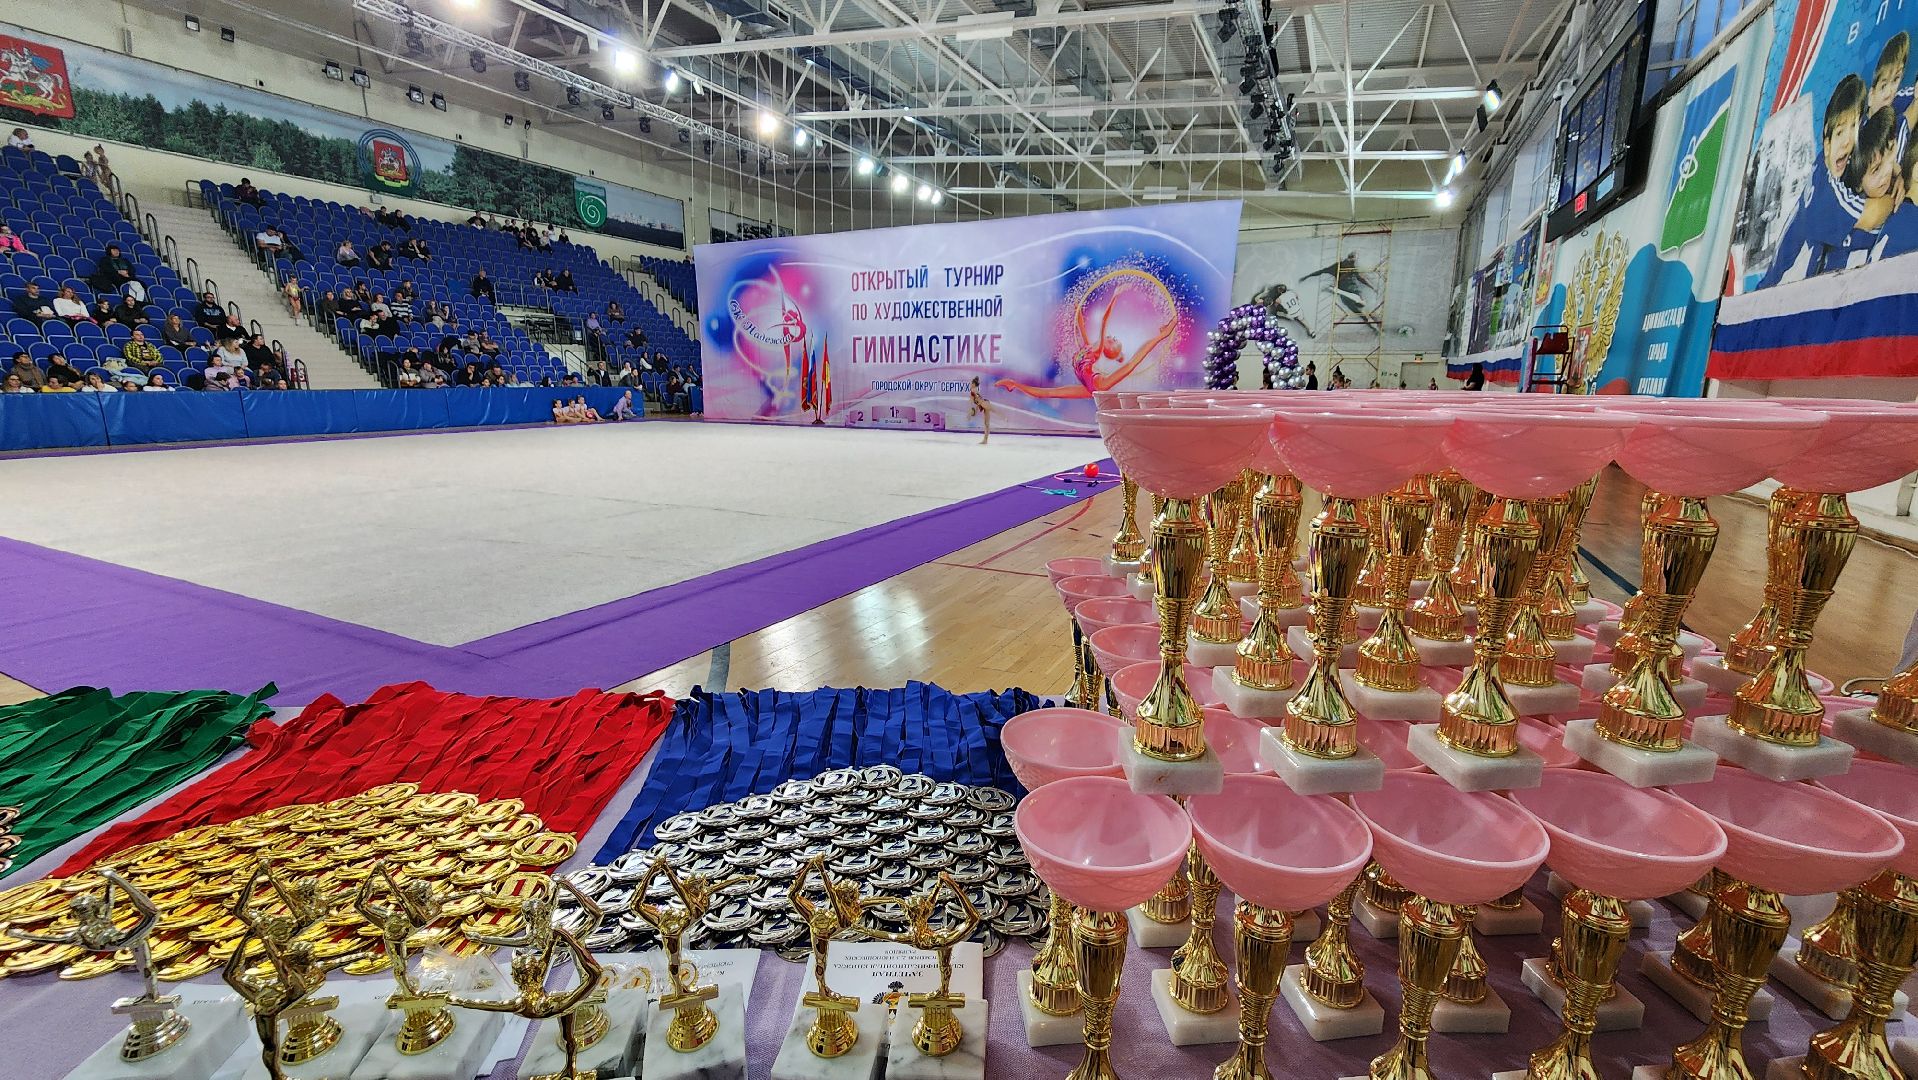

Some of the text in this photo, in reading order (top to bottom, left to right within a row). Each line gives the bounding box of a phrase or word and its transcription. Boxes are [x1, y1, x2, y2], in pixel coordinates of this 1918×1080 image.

[851, 265, 1004, 292] ОТКРЫТЫЙ ТУРНИР
[852, 295, 1003, 322] ПО ХУДОЖЕСТВЕННОЙ
[852, 334, 1002, 363] ГИМНАСТИКЕ
[871, 379, 912, 391] ГОРОДСКОЙ
[914, 381, 938, 391] ОКРУГ
[1009, 906, 1030, 922] 2
